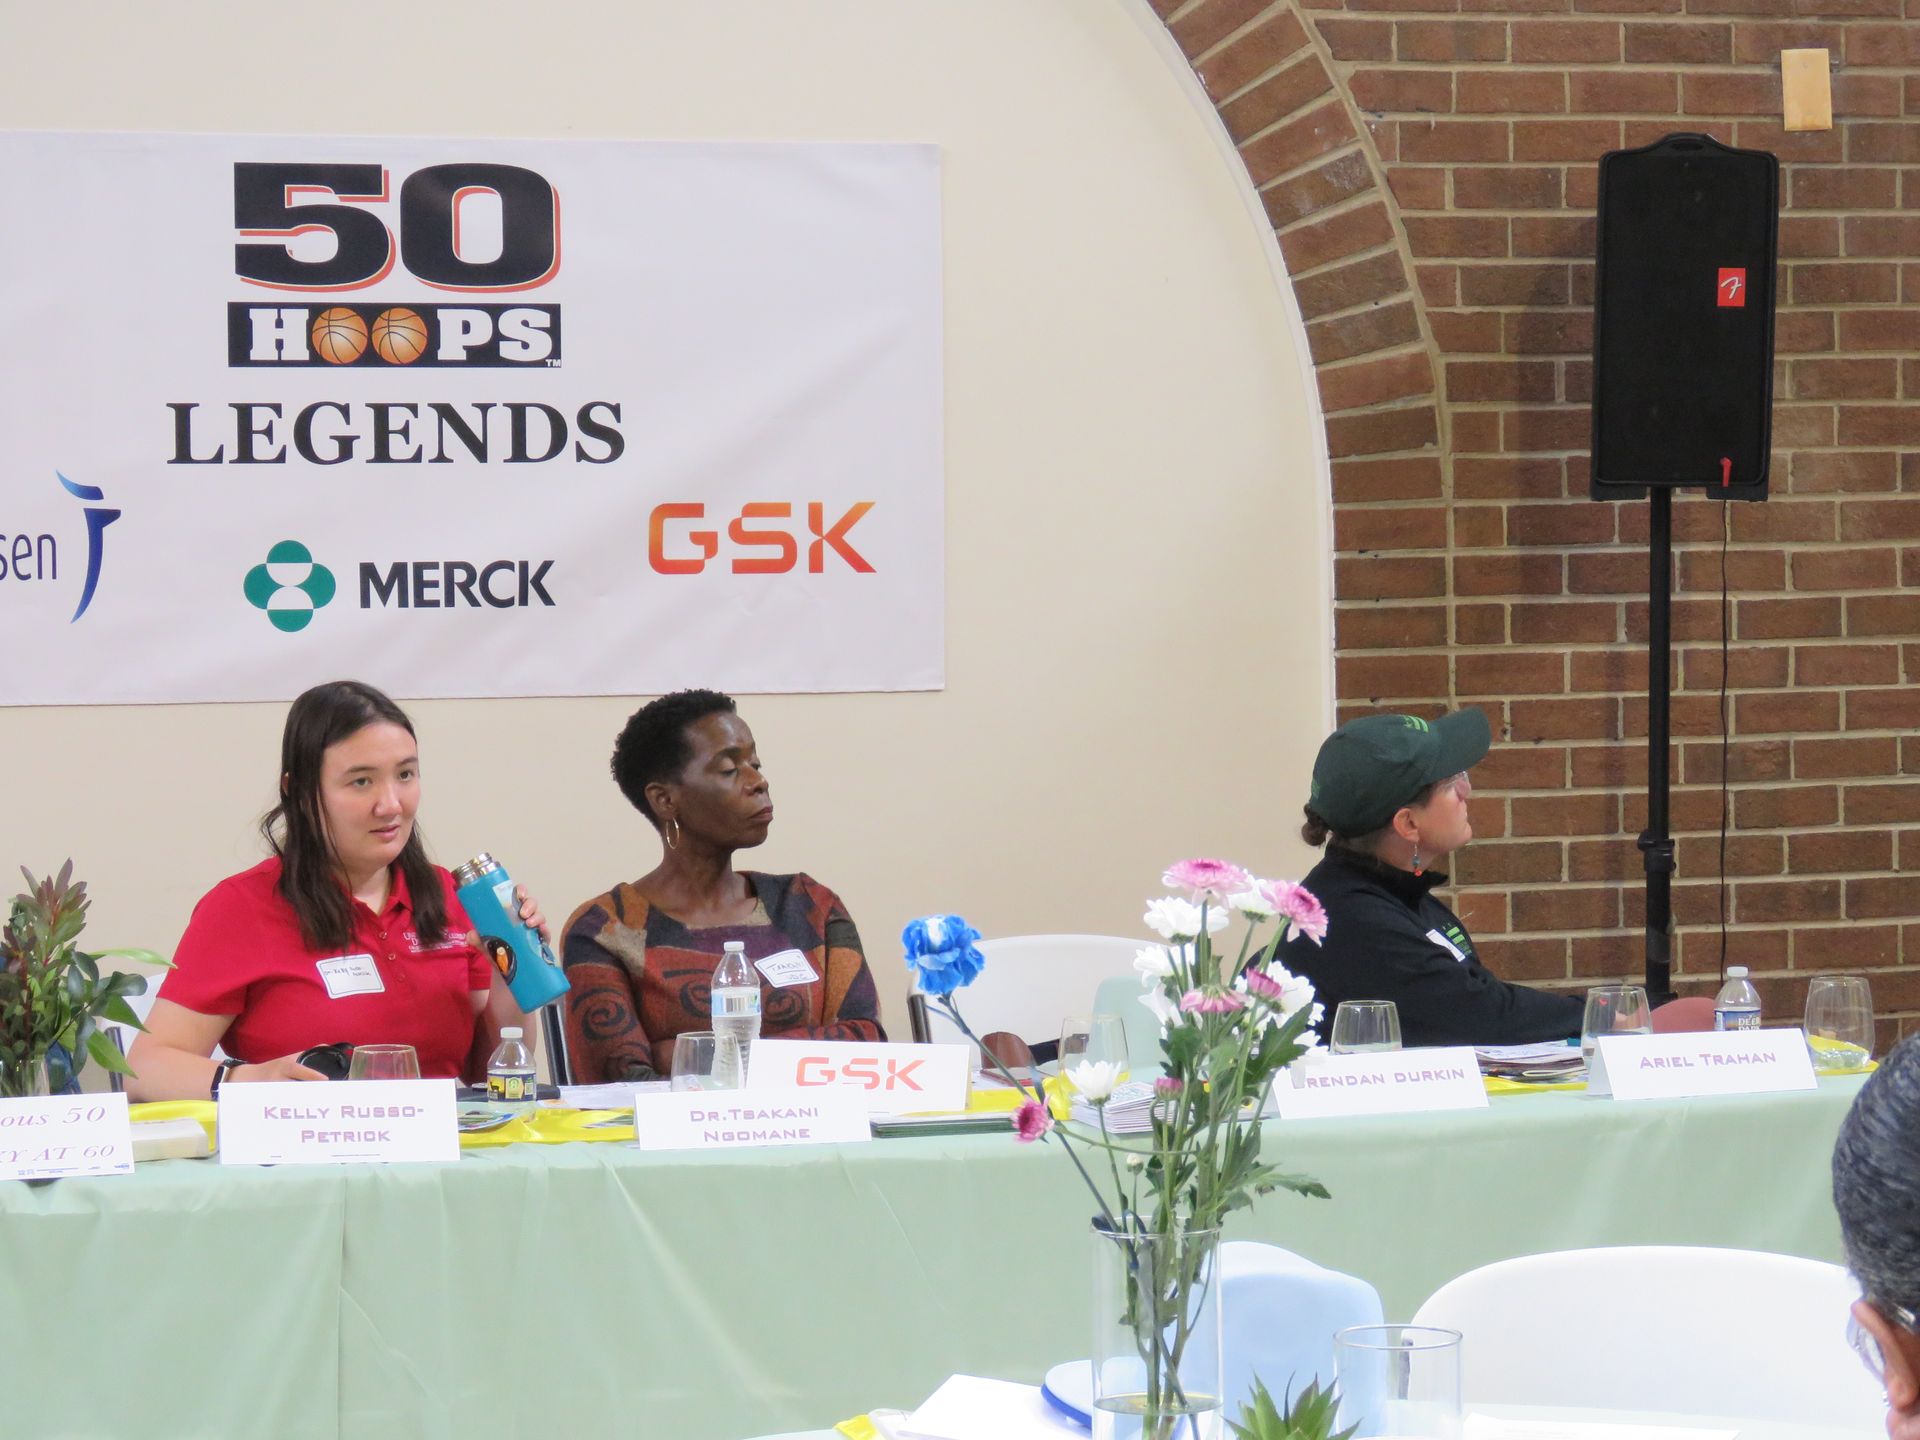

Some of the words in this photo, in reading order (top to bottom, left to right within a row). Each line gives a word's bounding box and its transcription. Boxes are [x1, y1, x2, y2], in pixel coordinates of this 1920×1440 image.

[234, 162, 561, 294] 50
[248, 308, 553, 365] HOOPS
[166, 402, 625, 465] LEGENDS
[648, 502, 877, 575] GSK
[359, 560, 556, 610] MERCK
[1639, 1056, 1694, 1069] ARIEL
[1699, 1052, 1776, 1066] TRAHAN
[796, 1056, 926, 1091] GSK
[1306, 1073, 1385, 1089] RENDAN
[1394, 1068, 1465, 1084] DURKIN
[62, 1106, 106, 1124] 50
[264, 1106, 330, 1119] KELLY
[340, 1105, 424, 1118] RUSSO-
[301, 1130, 391, 1143] PETRICK
[704, 1128, 811, 1142] NGOMANE
[33, 1147, 76, 1161] AT
[83, 1145, 115, 1158] 60
